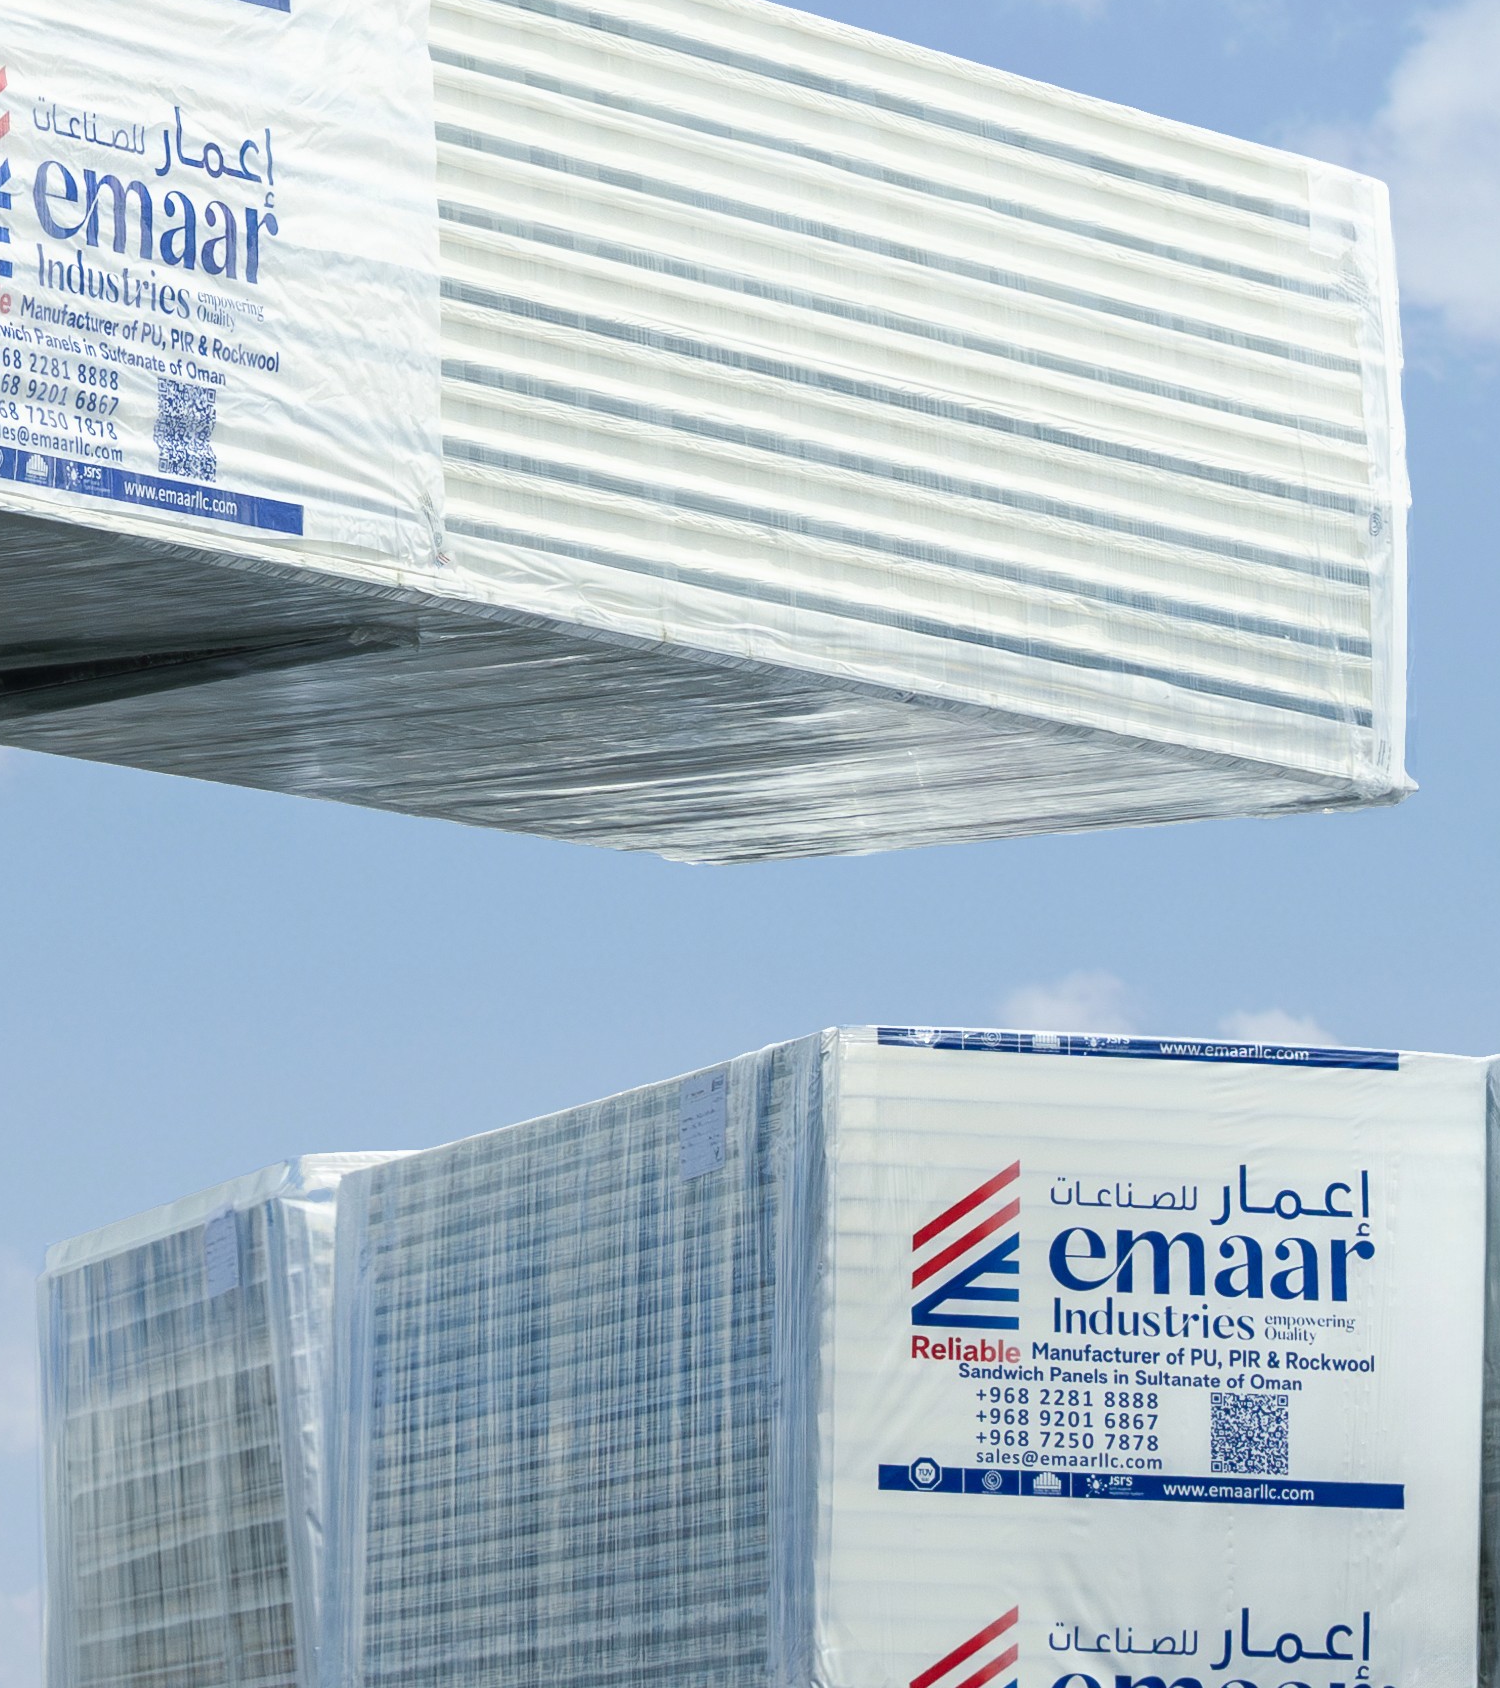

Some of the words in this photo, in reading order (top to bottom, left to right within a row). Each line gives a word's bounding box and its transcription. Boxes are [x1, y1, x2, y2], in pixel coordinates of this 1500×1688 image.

[32, 160, 279, 284] emaar
[37, 243, 190, 319] Industries
[21, 295, 119, 336] Manufacturer
[122, 320, 139, 341] of
[141, 322, 166, 351] PU,
[171, 328, 194, 353] PIR
[198, 335, 208, 357] &
[212, 338, 279, 373] Rockwool
[196, 304, 235, 333] Quality
[29, 352, 70, 380] 2281
[78, 363, 119, 391] 8888
[33, 327, 81, 354] Panels
[83, 338, 97, 357] in
[99, 341, 166, 373] Sultanate
[169, 358, 182, 376] of
[186, 361, 226, 386] Oman
[124, 479, 238, 516] www.emaarllc.com
[1160, 1041, 1310, 1063] www.emaarllc.com
[1050, 1177, 1197, 1211] للصناعات
[1210, 1164, 1370, 1237] إعمار
[1049, 1227, 1375, 1302] emaar
[1054, 1297, 1255, 1340] Industries
[1264, 1314, 1356, 1333] empowering
[1264, 1327, 1315, 1345] Quality
[912, 1335, 1020, 1363] Reliable
[1032, 1342, 1160, 1364] Manufacturer
[1166, 1347, 1185, 1365] of
[1191, 1348, 1222, 1369] PU,
[1229, 1350, 1261, 1368] PIR
[1267, 1351, 1280, 1369] &
[1286, 1352, 1375, 1372] Rockwool
[959, 1362, 1044, 1381] Sandwich
[1050, 1366, 1108, 1384] Panels
[1114, 1369, 1129, 1385] in
[1135, 1370, 1221, 1388] Sultanate
[1226, 1373, 1245, 1389] of
[1250, 1374, 1302, 1391] Oman
[976, 1387, 1029, 1404] +968
[1040, 1389, 1093, 1407] 2281
[1104, 1391, 1158, 1409] 8888
[976, 1408, 1029, 1426] +968
[1040, 1410, 1093, 1428] 9201
[1105, 1412, 1158, 1430] 6867
[976, 1429, 1029, 1447] +968
[1040, 1431, 1094, 1449] 7250
[1105, 1433, 1159, 1451] 7878
[976, 1448, 1162, 1470] sales@emaarllc.com
[1163, 1484, 1314, 1501] www.emaarllc.com
[1049, 1622, 1198, 1656] للصناعات
[1210, 1607, 1370, 1680] إعمار
